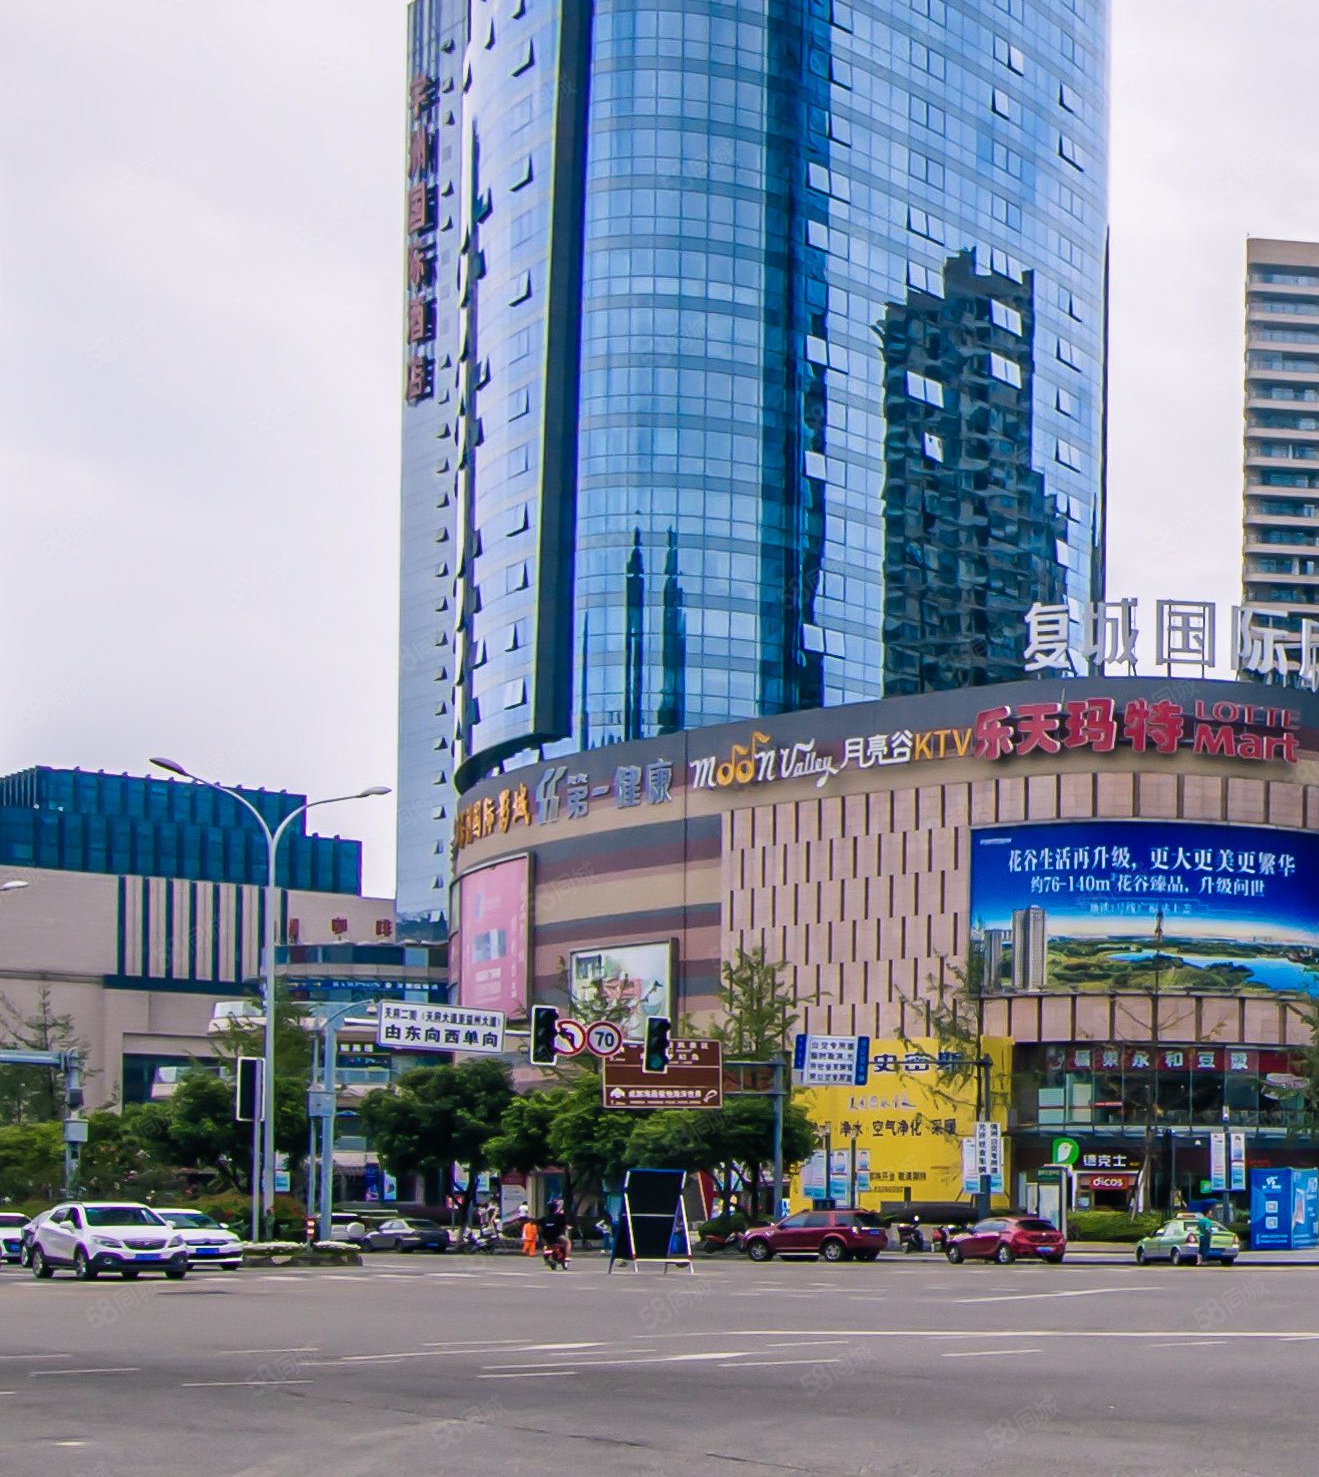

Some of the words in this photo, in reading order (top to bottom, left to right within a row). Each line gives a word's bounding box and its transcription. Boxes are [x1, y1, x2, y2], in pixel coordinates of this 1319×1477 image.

[1194, 699, 1297, 727] LOTTE
[973, 697, 1184, 761] 乐天玛特
[1194, 724, 1298, 763] Mart
[567, 758, 673, 819] 第一健康
[385, 1024, 498, 1048] 由东向西单向
[595, 1031, 614, 1047] 70
[873, 1120, 922, 1136] 空气净化
[1083, 1154, 1127, 1167] 德克士
[1093, 1176, 1123, 1188] dicos
